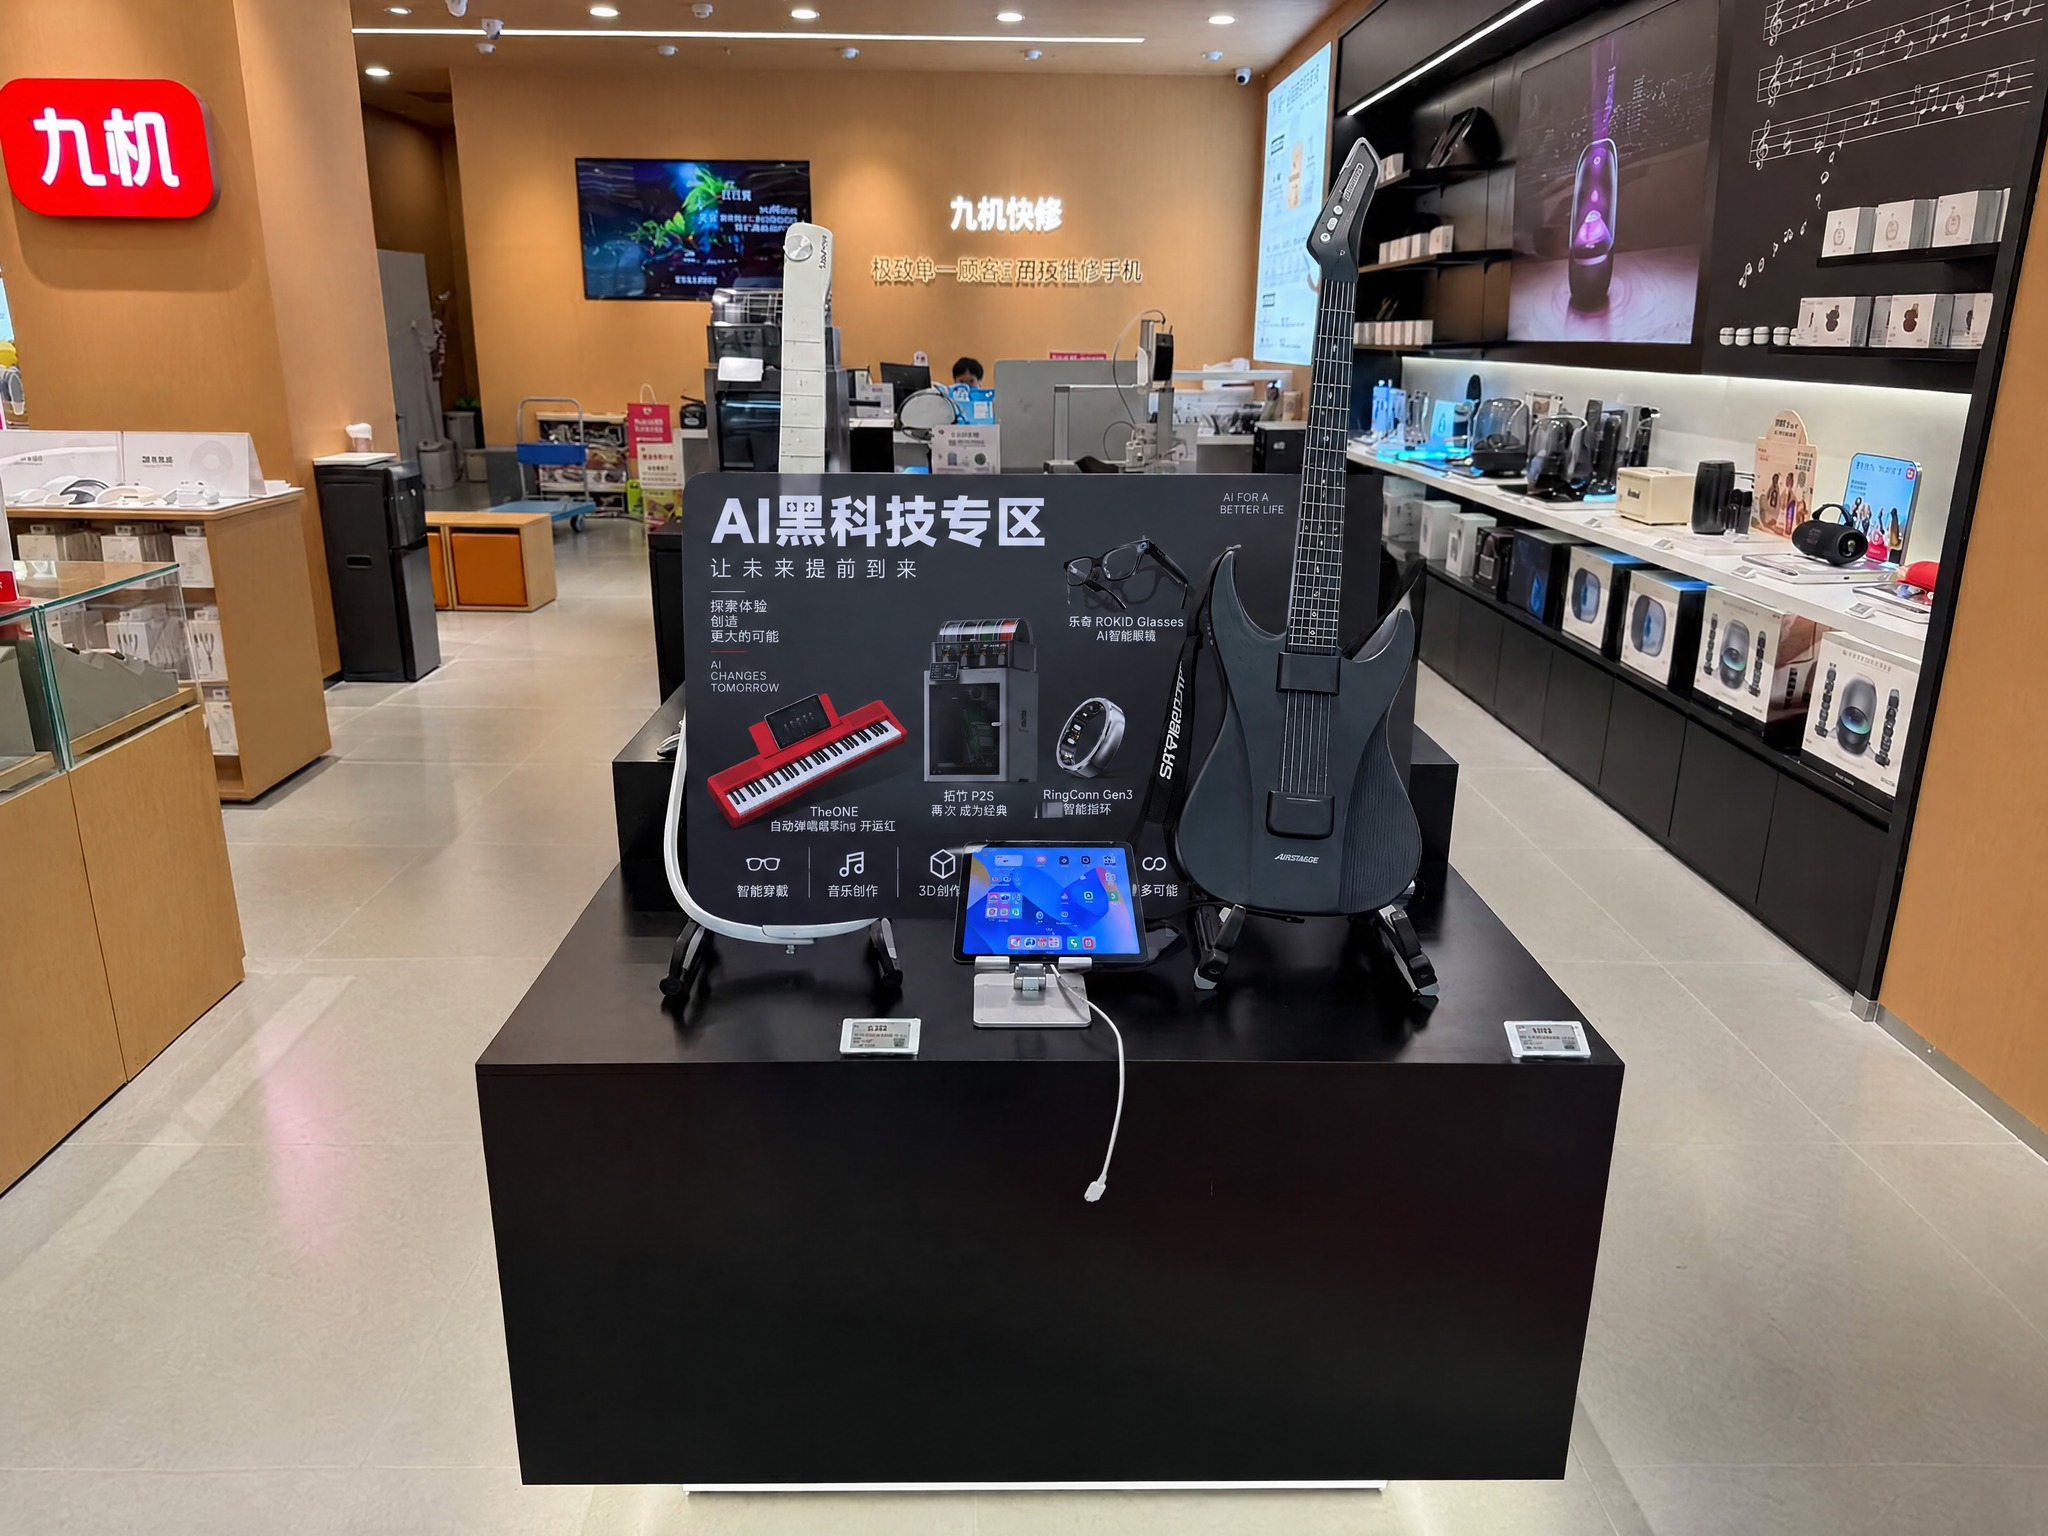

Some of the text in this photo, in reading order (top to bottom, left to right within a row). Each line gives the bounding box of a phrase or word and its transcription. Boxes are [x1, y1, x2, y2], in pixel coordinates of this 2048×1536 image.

[32, 107, 180, 188] 九机
[949, 195, 1064, 232] 九机快修
[1222, 492, 1269, 502] AI FOR A
[1219, 504, 1285, 515] BETTER LIFE
[710, 495, 1046, 548] AI黑科技专区
[710, 558, 917, 580] 让未来提前到来
[710, 599, 768, 614] 探索体验
[710, 614, 738, 628] 创造
[1068, 615, 1184, 628] 乐奇 ROKID Glasses
[710, 629, 780, 644] 更大的可能
[1096, 629, 1157, 643] AI智能眼镜
[710, 660, 722, 670] AI
[710, 671, 767, 681] CHANGES
[710, 683, 780, 693] TOMORROW
[943, 789, 995, 802] 拓竹 P2S
[1043, 789, 1133, 802] RingConn Gen3
[810, 806, 859, 817] TheONE
[959, 804, 1008, 817] 成为经典
[1063, 803, 1112, 816] 智能指环
[859, 819, 896, 832] 开运红
[736, 884, 789, 898] 智能穿戴
[827, 884, 879, 898] 音乐创作
[918, 884, 961, 898] 3D创作
[1133, 884, 1179, 898] 多可能
